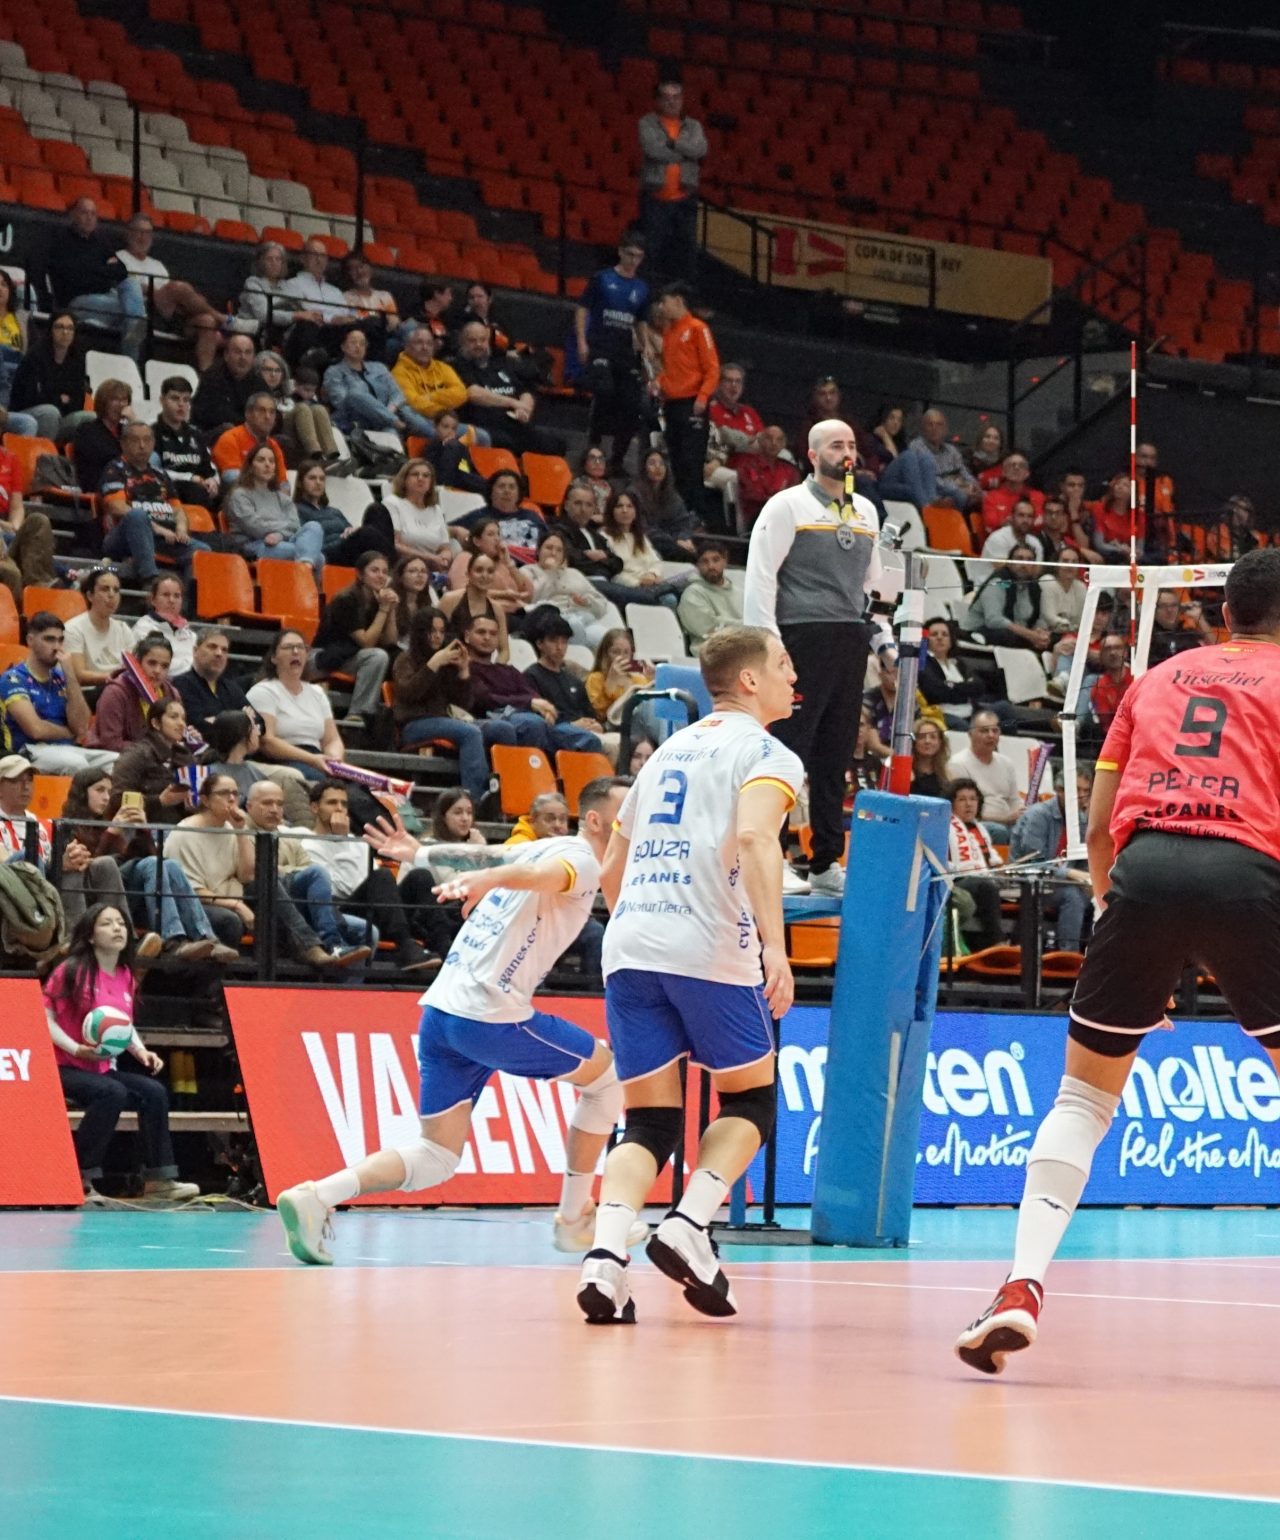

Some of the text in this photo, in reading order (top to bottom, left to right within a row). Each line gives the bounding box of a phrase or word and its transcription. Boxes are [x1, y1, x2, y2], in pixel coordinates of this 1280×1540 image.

[1174, 696, 1228, 758] 9
[648, 769, 688, 825] 3
[777, 1044, 1034, 1117] mten
[1119, 1121, 1177, 1178] feel
[1177, 1129, 1226, 1174] the
